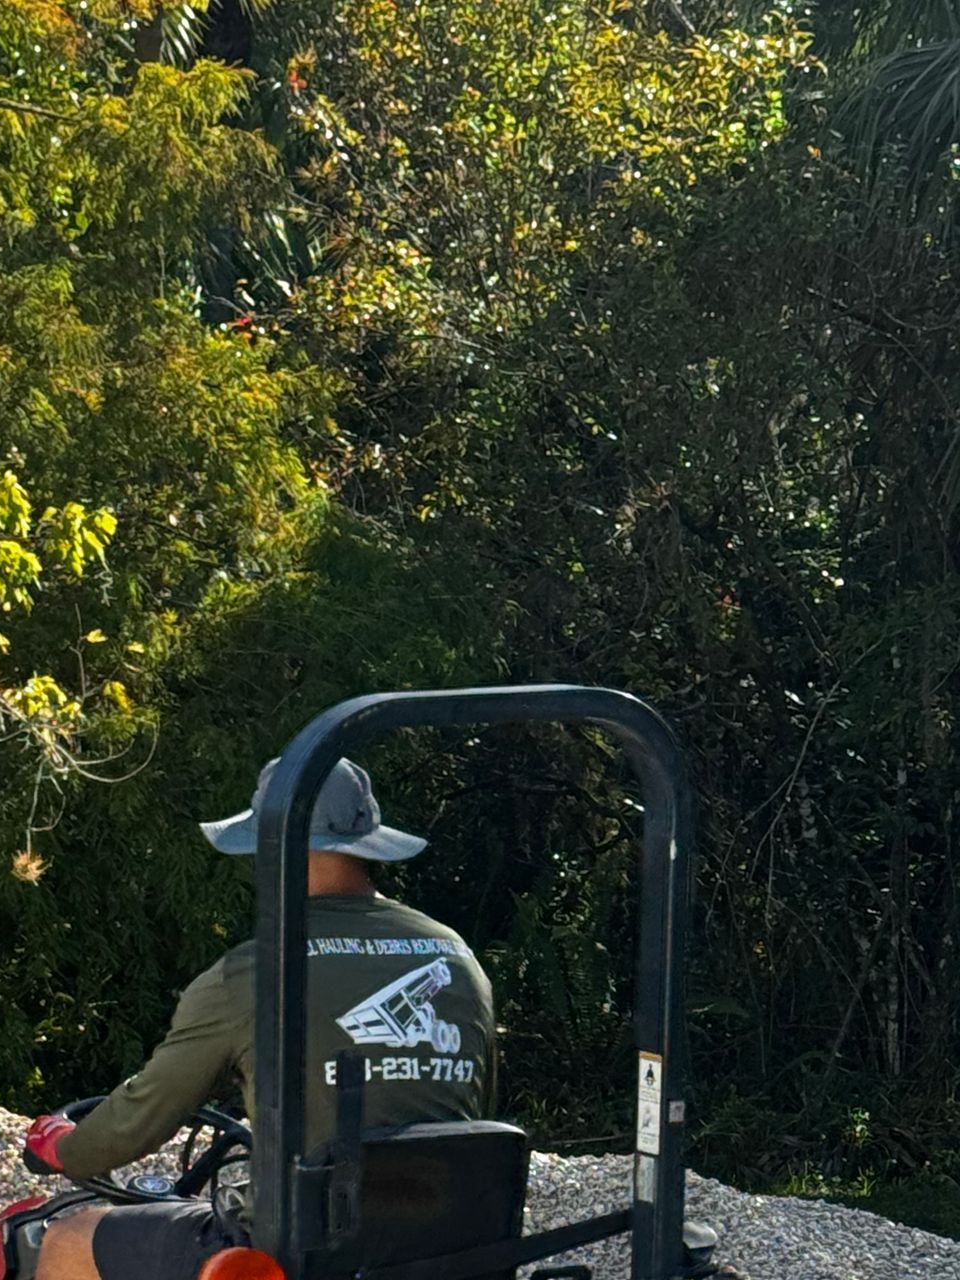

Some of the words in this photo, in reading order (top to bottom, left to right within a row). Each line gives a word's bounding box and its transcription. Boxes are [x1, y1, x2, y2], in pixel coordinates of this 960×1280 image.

[316, 938, 365, 955] HAULING
[365, 940, 375, 955] &
[374, 938, 411, 955] DEBRIS
